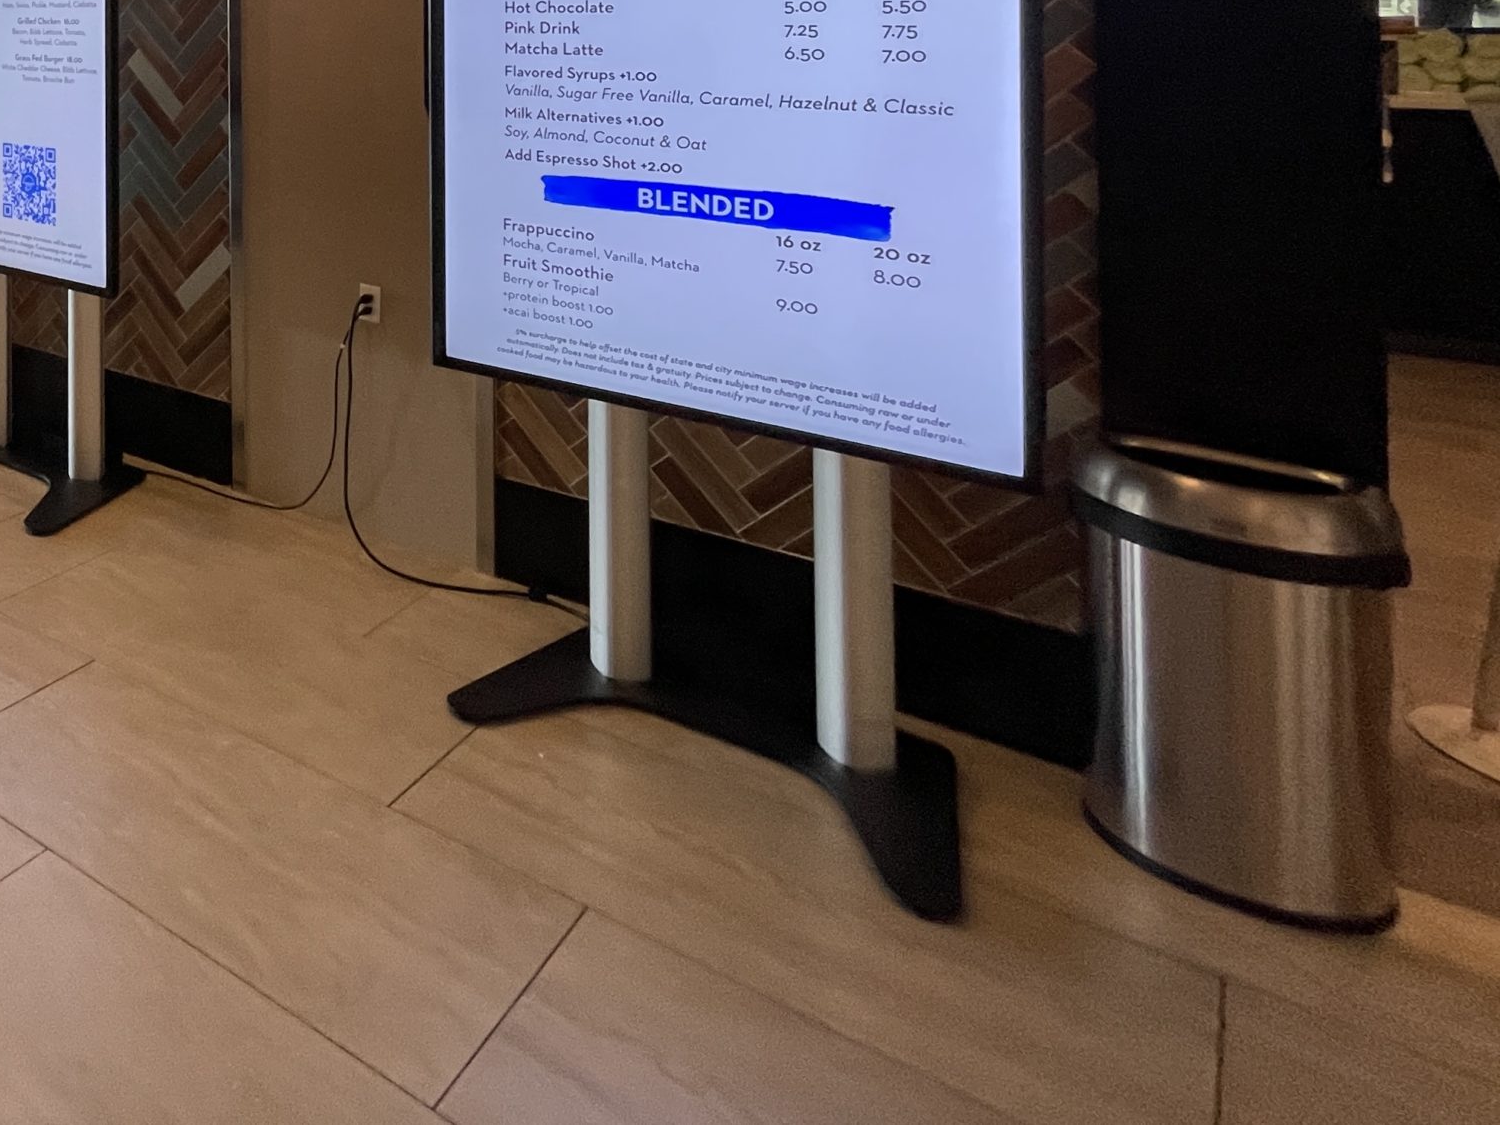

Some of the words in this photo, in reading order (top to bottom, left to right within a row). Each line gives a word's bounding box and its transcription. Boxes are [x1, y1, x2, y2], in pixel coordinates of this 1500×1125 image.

[503, 0, 531, 14] Hot
[504, 19, 536, 35] Pink
[539, 19, 580, 35] Drink
[783, 23, 819, 39] 7.25
[881, 24, 919, 40] 7.75
[504, 40, 559, 56] Matcha
[562, 41, 604, 57] Latte
[503, 64, 564, 79] Flavored
[566, 65, 616, 84] Syrups
[504, 82, 553, 99] Vanilla,
[555, 84, 598, 103] Sugar
[600, 86, 634, 102] Free
[638, 88, 694, 106] Vanilla,
[698, 90, 773, 110] Caramel,
[777, 93, 858, 112] Hazelnut
[862, 96, 878, 113] &
[883, 97, 955, 117] Classic
[504, 106, 533, 120] Milk
[535, 107, 623, 125] Alternatives
[503, 123, 530, 141] Soy,
[532, 126, 589, 144] Almond,
[592, 129, 656, 148] Coconut
[658, 134, 671, 149] &
[675, 135, 707, 151] Oat
[503, 147, 532, 162] Add
[535, 149, 599, 167] Espresso
[601, 154, 637, 171] Shot
[637, 187, 774, 221] BLENDED
[502, 216, 595, 242] Frappuccino
[775, 234, 795, 249] 16
[799, 239, 822, 252] oz
[502, 235, 544, 252] Mocha,
[545, 240, 600, 260] Caramel,
[602, 248, 647, 266] Vanilla,
[650, 255, 700, 273] Matcha
[873, 246, 901, 261] 20
[906, 252, 931, 265] oz
[502, 252, 538, 272] Fruit
[540, 258, 614, 283] Smoothie
[775, 258, 814, 275] 7.50
[502, 270, 534, 289] Berry
[536, 279, 549, 288] or
[551, 278, 599, 297] Tropical
[872, 268, 922, 289] 8.00
[551, 294, 585, 312] boost
[588, 303, 614, 316] 1.00
[775, 297, 818, 315] 9.00
[532, 307, 565, 325] boost
[568, 315, 593, 329] 1.00
[543, 355, 562, 366] may
[561, 356, 574, 367] be
[618, 368, 629, 378] to
[801, 403, 811, 416] if
[811, 408, 832, 419] you
[860, 418, 882, 430] any
